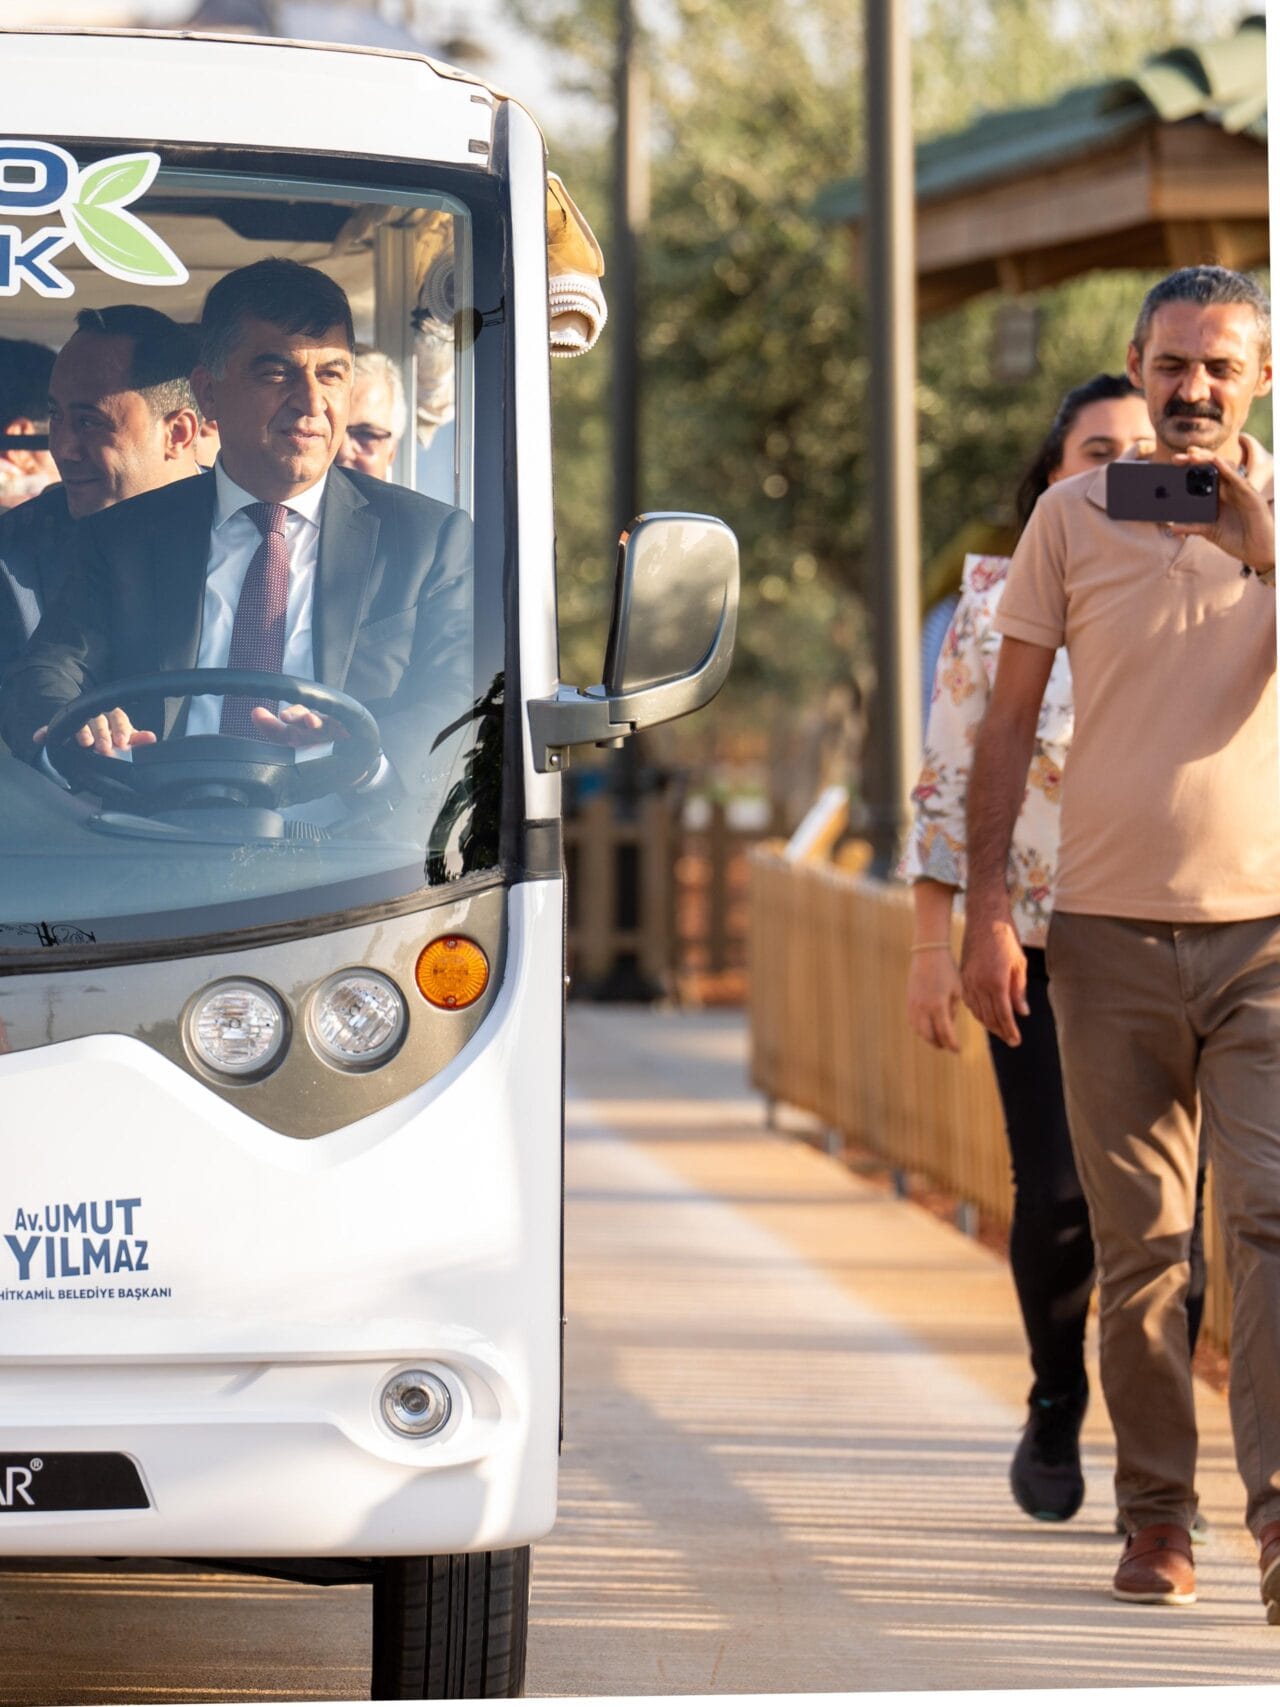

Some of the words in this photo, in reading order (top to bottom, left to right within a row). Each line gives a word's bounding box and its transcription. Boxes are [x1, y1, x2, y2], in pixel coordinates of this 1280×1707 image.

[3, 1234, 149, 1280] YILMAZ
[58, 1285, 114, 1299] BELEDİYE
[118, 1287, 172, 1301] BAŞKANI
